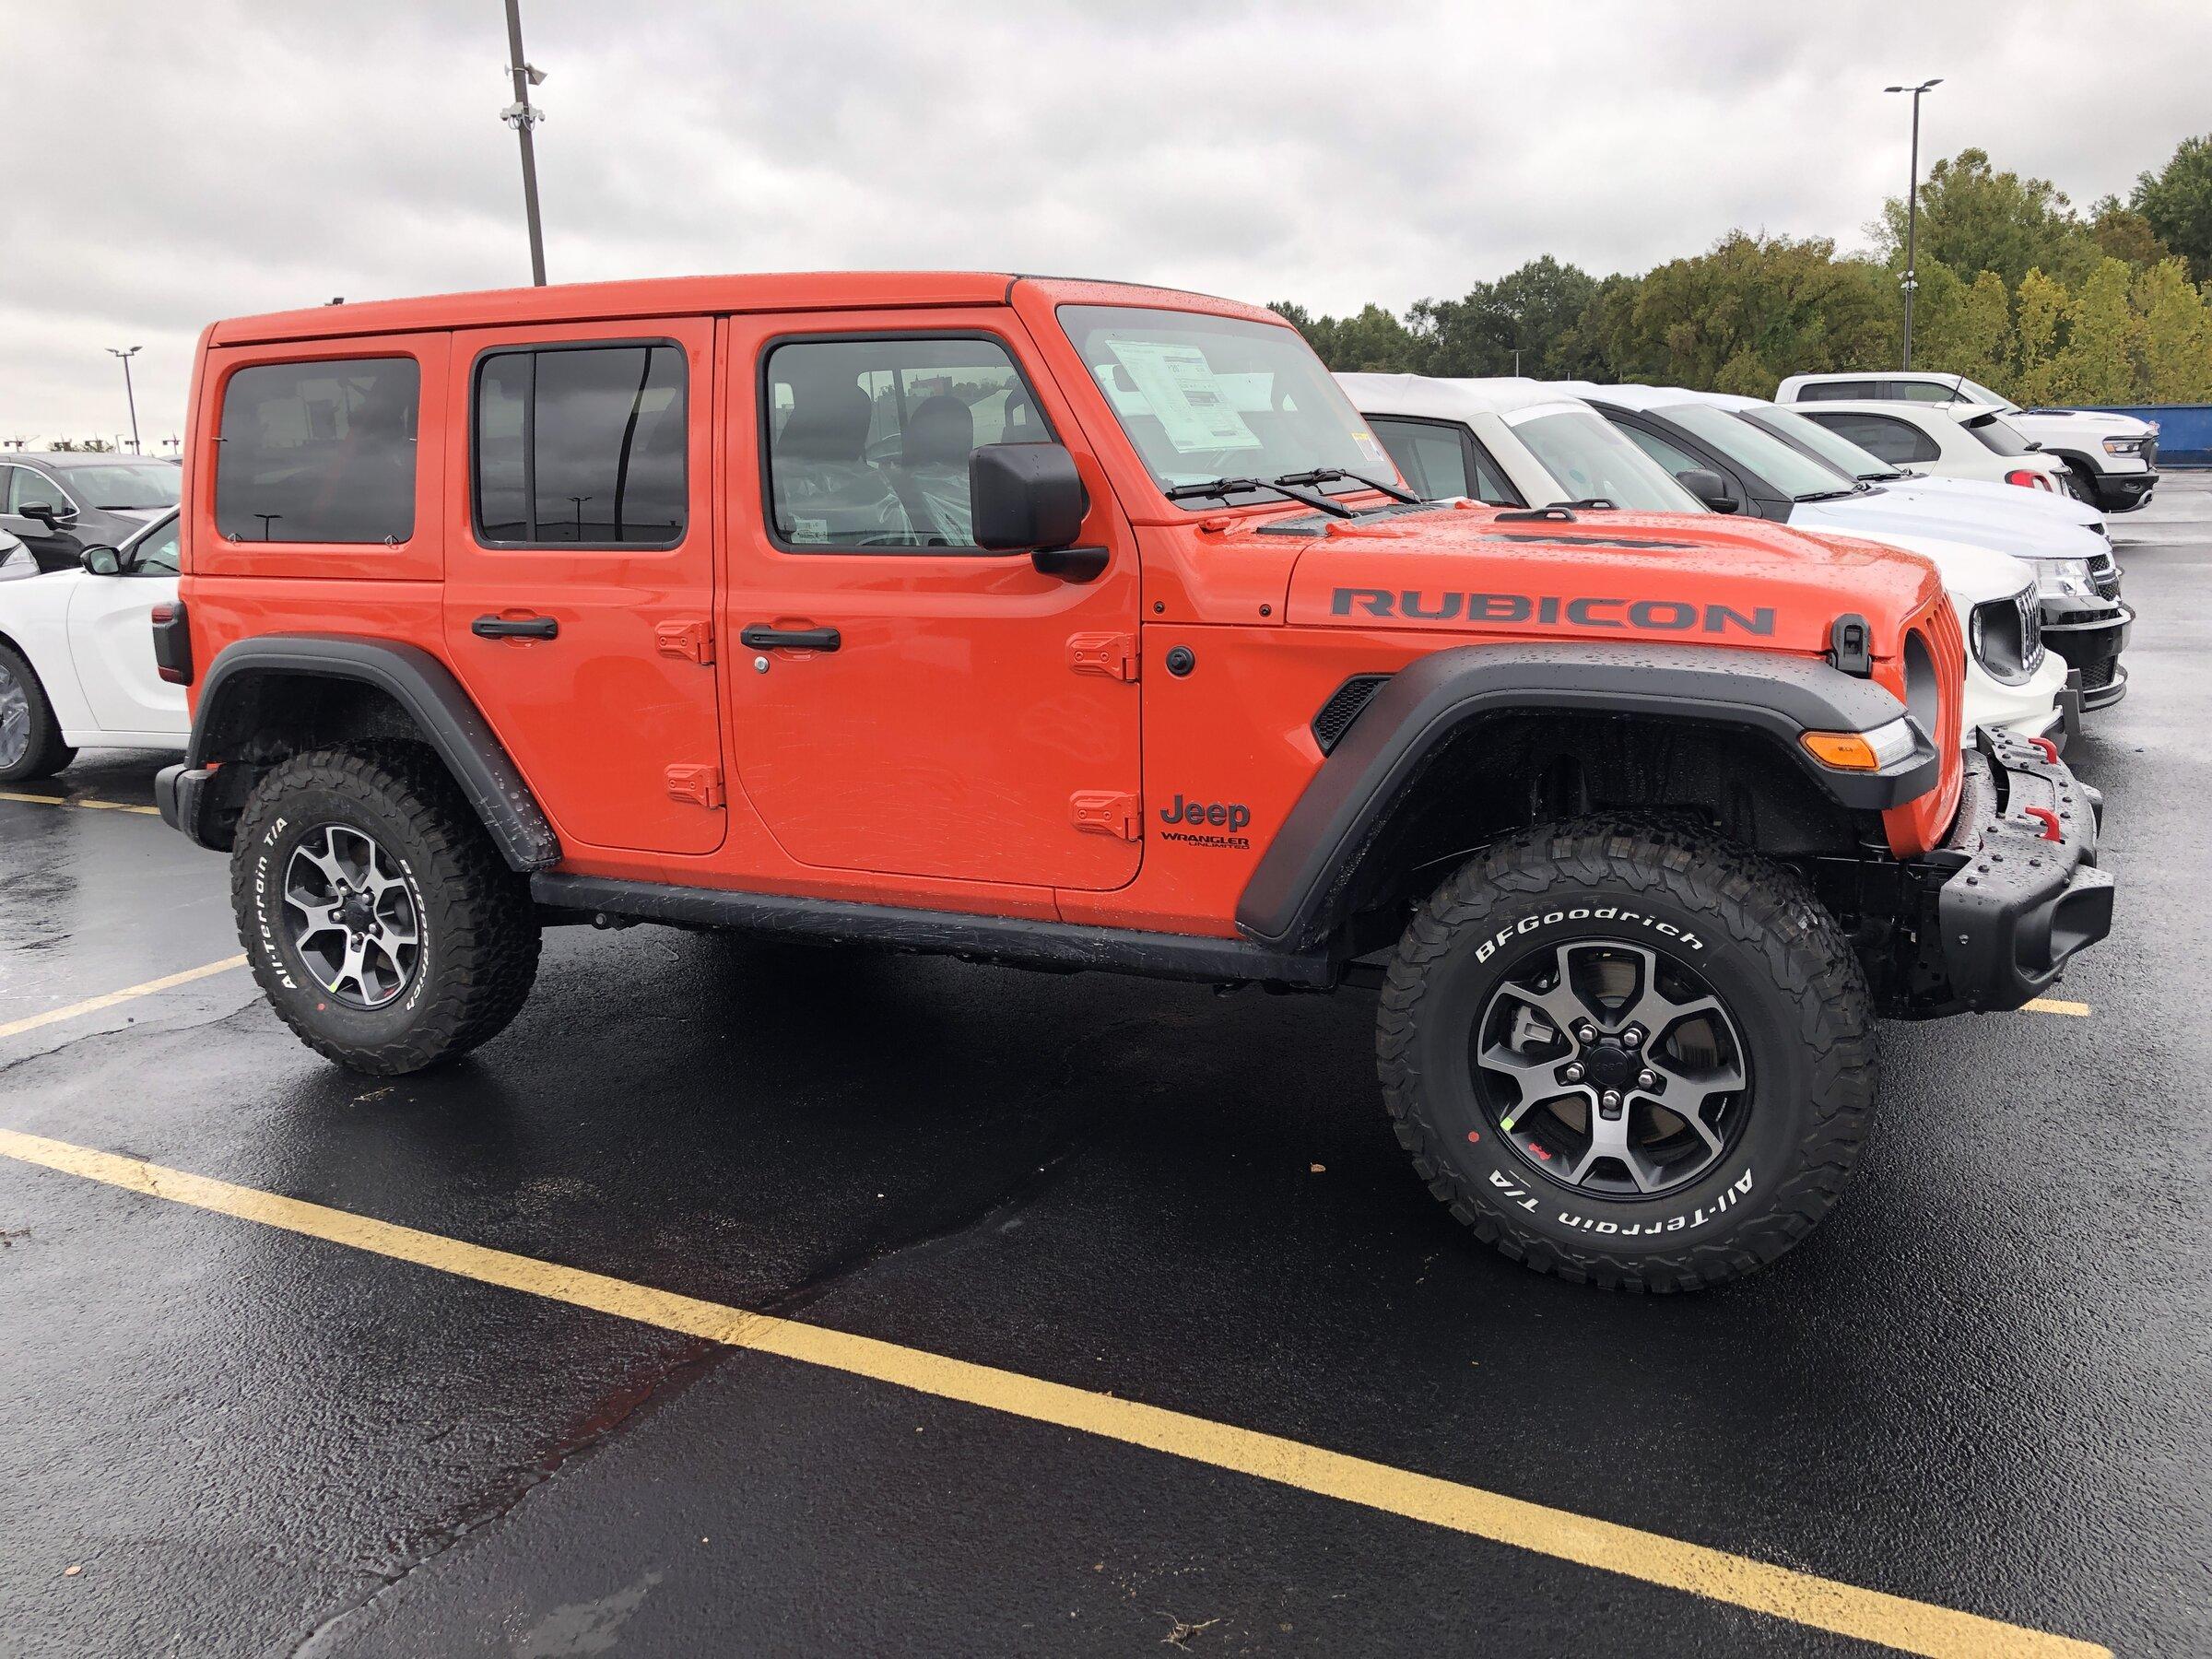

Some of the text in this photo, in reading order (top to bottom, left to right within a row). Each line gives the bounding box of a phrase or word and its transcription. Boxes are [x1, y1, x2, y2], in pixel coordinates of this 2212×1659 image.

[1331, 587, 1775, 635] RUBICON
[1159, 794, 1251, 832] Jeep
[1160, 831, 1251, 846] WRANGLER
[1188, 841, 1251, 850] UNLIMITED
[253, 817, 299, 990] All-Terrain T/A
[1475, 907, 1703, 963] BFGoodrich
[1488, 1167, 1754, 1236] All-Terrain T/A
